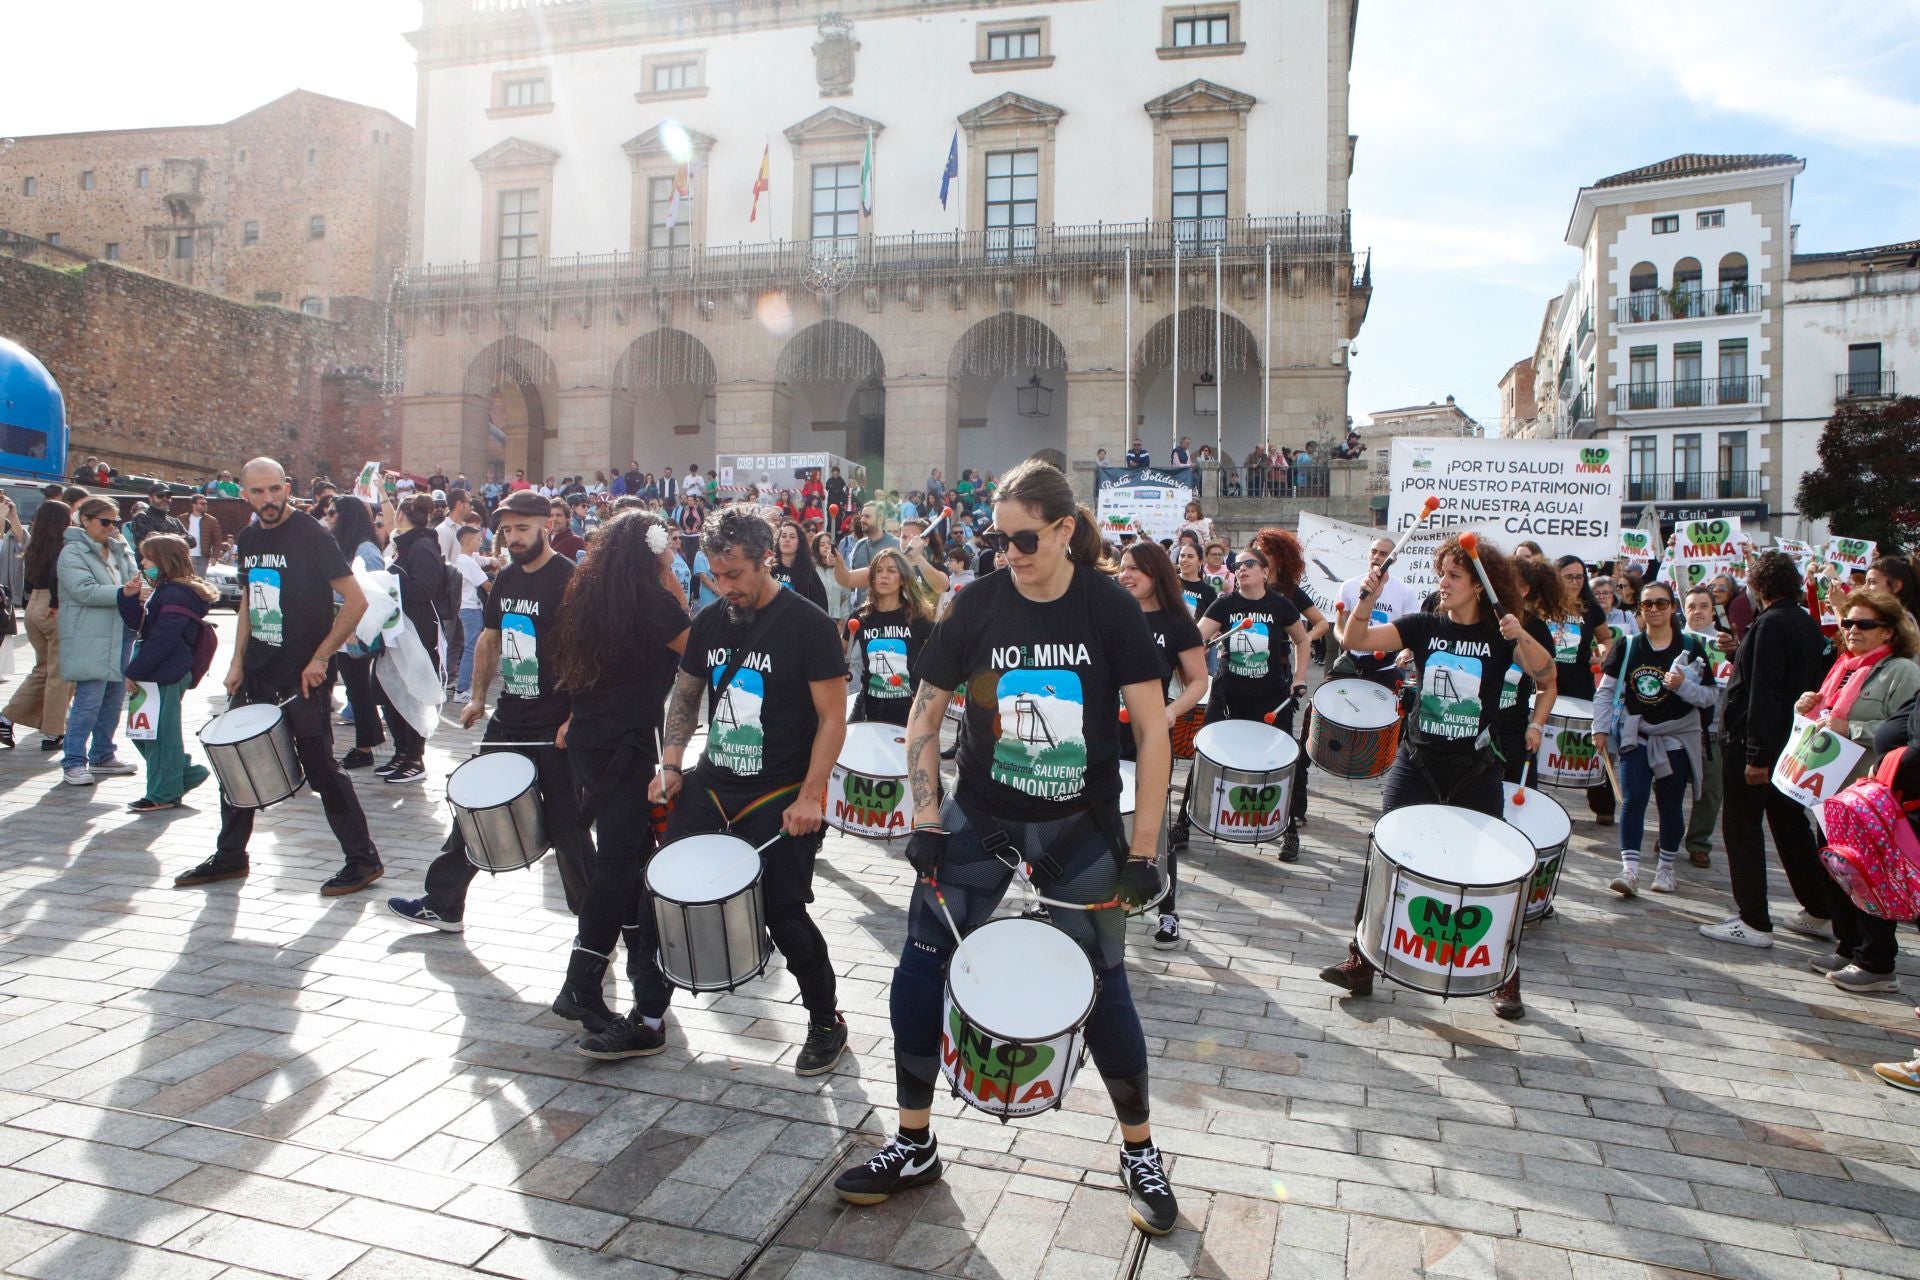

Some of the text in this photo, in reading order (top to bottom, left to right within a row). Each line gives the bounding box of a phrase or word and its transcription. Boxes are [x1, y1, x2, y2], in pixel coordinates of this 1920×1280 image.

[1585, 448, 1605, 458] NO
[1447, 460, 1482, 474] ¡POR
[1486, 461, 1505, 473] TU
[1508, 461, 1564, 474] SALUD!
[1575, 464, 1611, 473] MINA
[1401, 478, 1611, 496] ¡POR NUESTRO PATRIMONIO!
[1461, 499, 1531, 512] NUESTRA
[1534, 501, 1583, 514] AGUA!
[1505, 513, 1608, 537] CÁCERES!
[1693, 520, 1723, 536] NO
[1628, 533, 1644, 543] NO
[1843, 540, 1864, 550] NO
[1621, 546, 1649, 557] MINA
[1683, 543, 1736, 558] MINA
[1831, 552, 1866, 565] MINA
[244, 554, 287, 568] NO MINA
[1230, 612, 1274, 624] NO MINA
[864, 628, 878, 639] NO
[884, 626, 912, 639] MINA
[1428, 637, 1447, 651] NO
[1455, 641, 1491, 657] MINA
[707, 648, 727, 668] NO
[991, 645, 1020, 669] NO
[1034, 643, 1091, 667] MINA
[1444, 713, 1479, 726] SALVEMOS
[1548, 752, 1600, 771] MINA
[1033, 763, 1087, 779] SALVEMOS
[854, 777, 896, 799] NO
[1012, 777, 1086, 798] MONTAÑA
[1240, 786, 1277, 803] NO
[854, 797, 883, 809] A LA
[1241, 803, 1266, 811] A LA
[835, 800, 905, 829] MINA
[1220, 808, 1281, 828] MINA
[1423, 898, 1482, 930] NO
[1423, 926, 1463, 943] A LA
[914, 941, 938, 953] ALLSIX
[1393, 927, 1491, 969] MINA
[963, 1022, 1038, 1068] NO
[940, 1031, 1055, 1104] MINA
[980, 1063, 1012, 1079] LA
